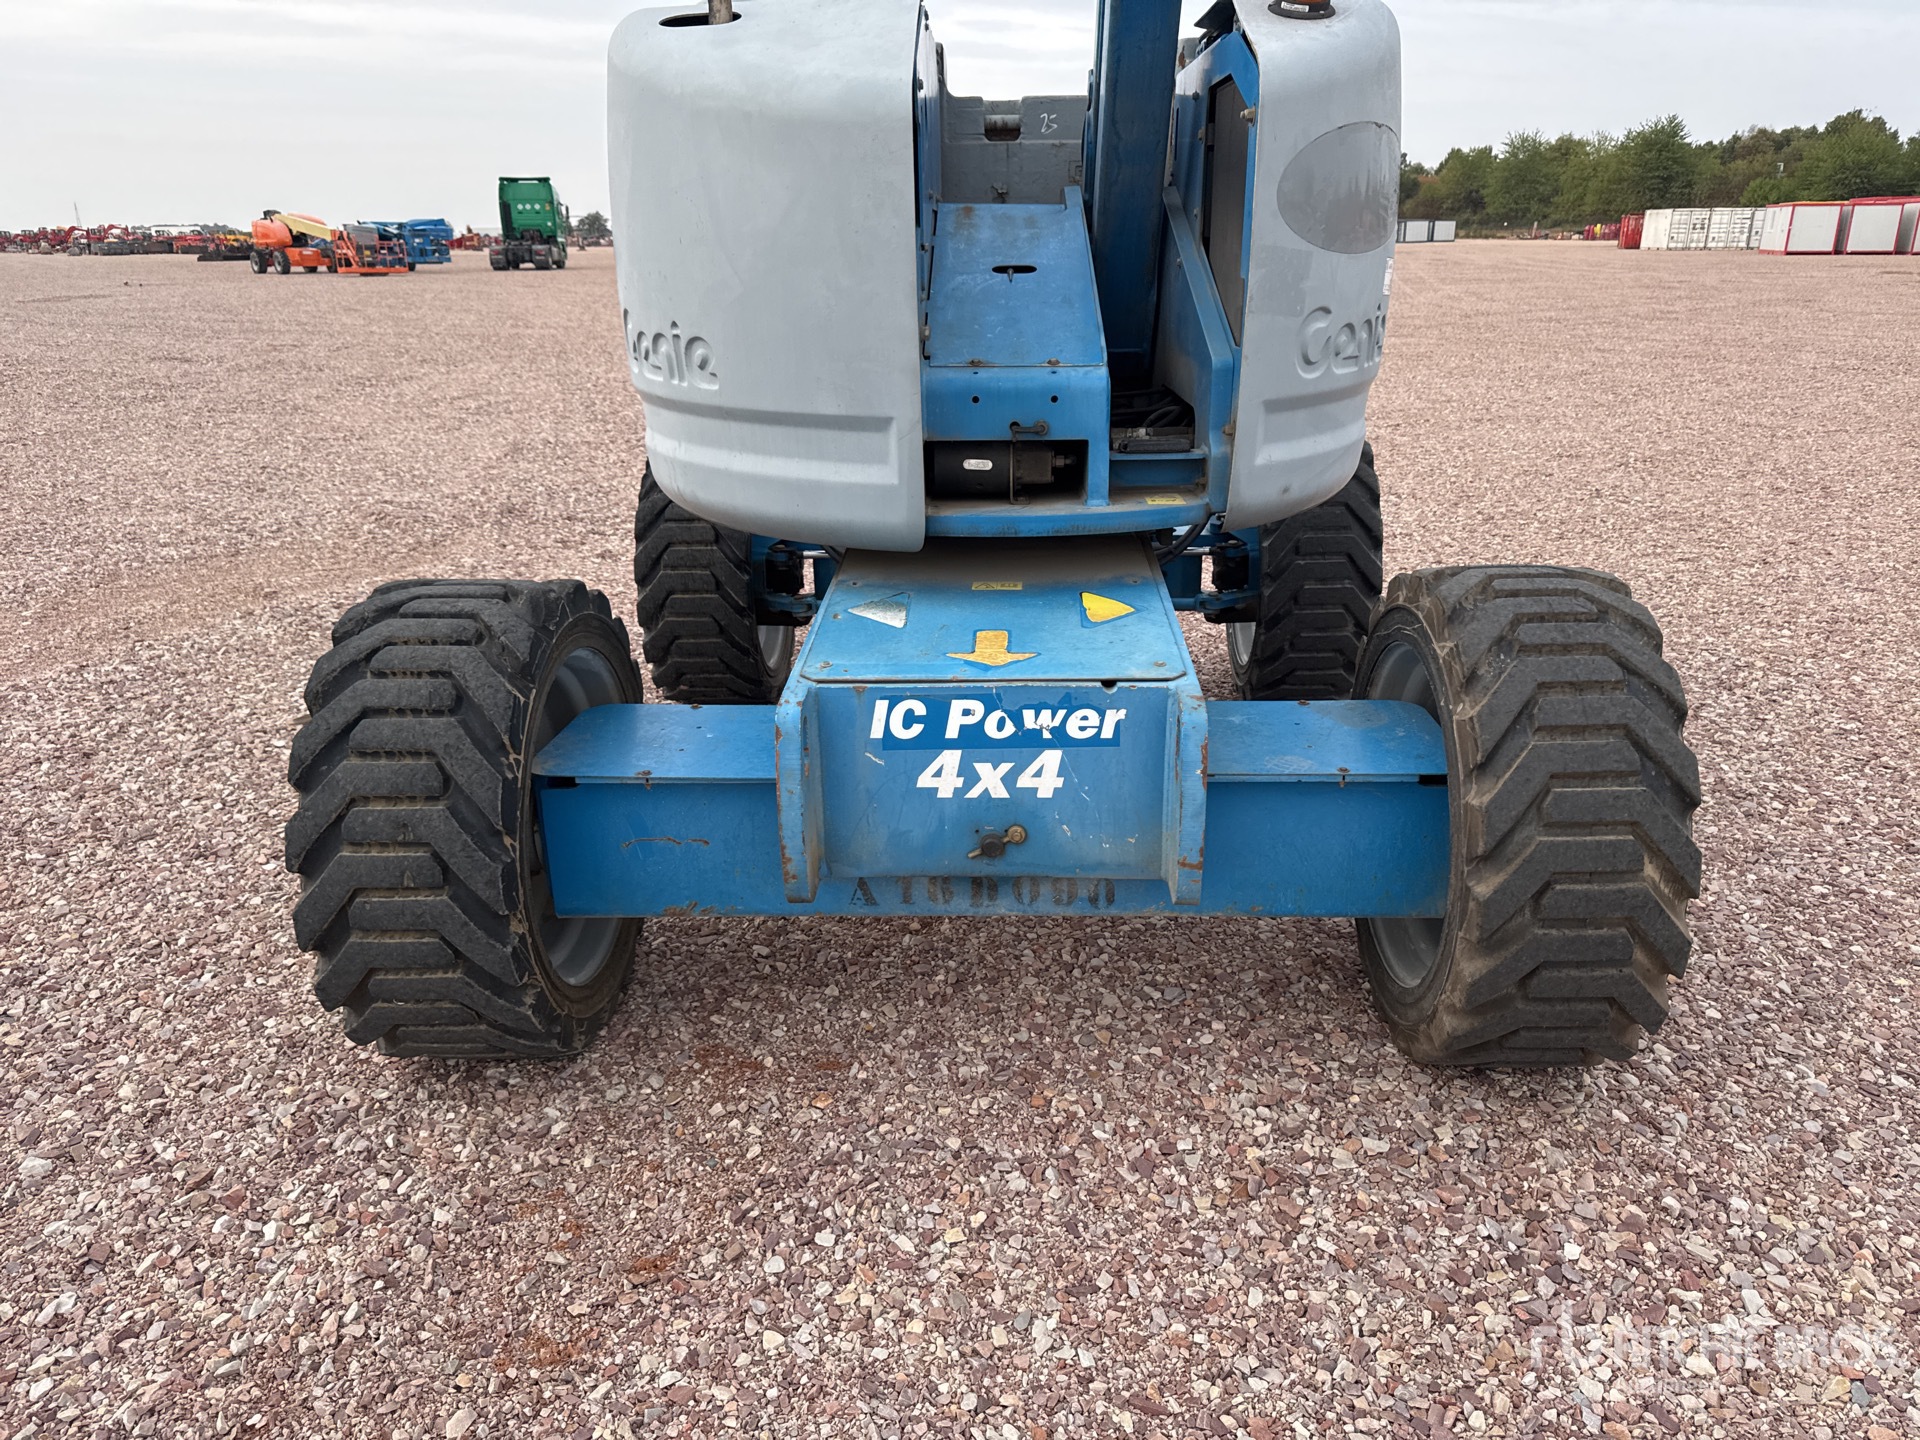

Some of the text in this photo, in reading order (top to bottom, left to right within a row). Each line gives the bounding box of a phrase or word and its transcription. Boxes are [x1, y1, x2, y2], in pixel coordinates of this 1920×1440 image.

[1040, 113, 1058, 135] 25
[869, 699, 1127, 740] IC Power
[916, 749, 1065, 799] 4x4
